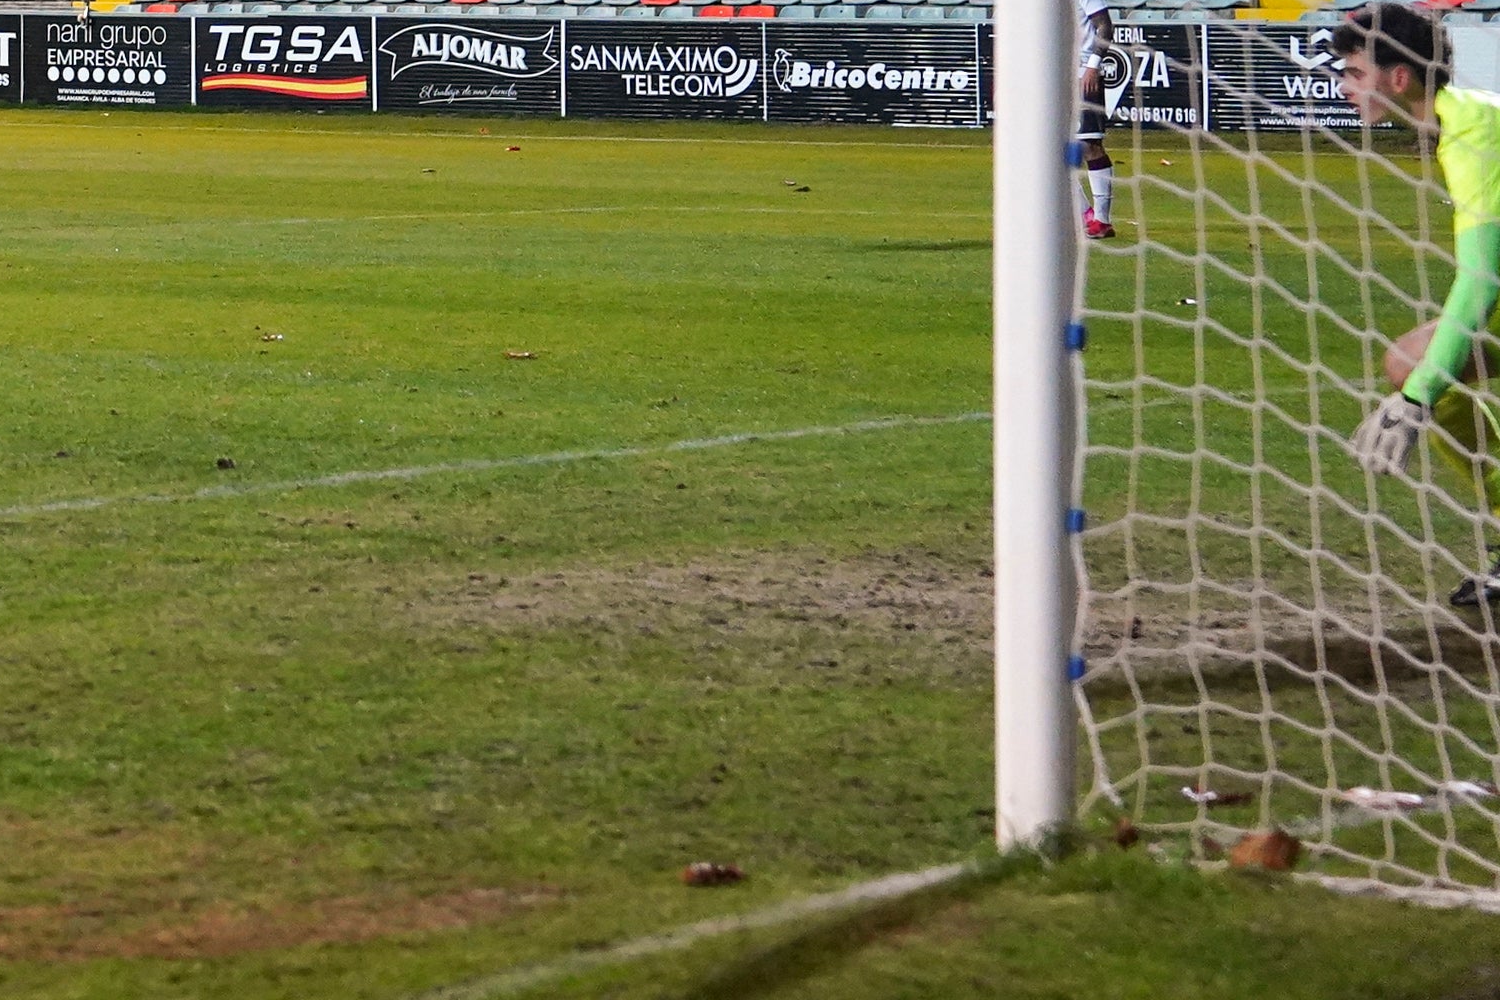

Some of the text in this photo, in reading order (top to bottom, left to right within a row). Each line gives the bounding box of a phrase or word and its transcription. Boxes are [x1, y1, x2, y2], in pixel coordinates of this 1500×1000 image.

[100, 25, 166, 50] grupo
[209, 25, 364, 62] TGSA
[47, 49, 166, 69] EMPRESARIAL
[411, 32, 528, 71] ALJOMAR
[570, 42, 738, 74] SANMÁXIMO
[204, 63, 318, 73] LOGISTICS
[788, 61, 969, 90] BricoCentro
[621, 74, 723, 97] TELECOM
[1282, 75, 1346, 99] Wak
[1153, 107, 1174, 123] 817
[1175, 108, 1197, 123] 616
